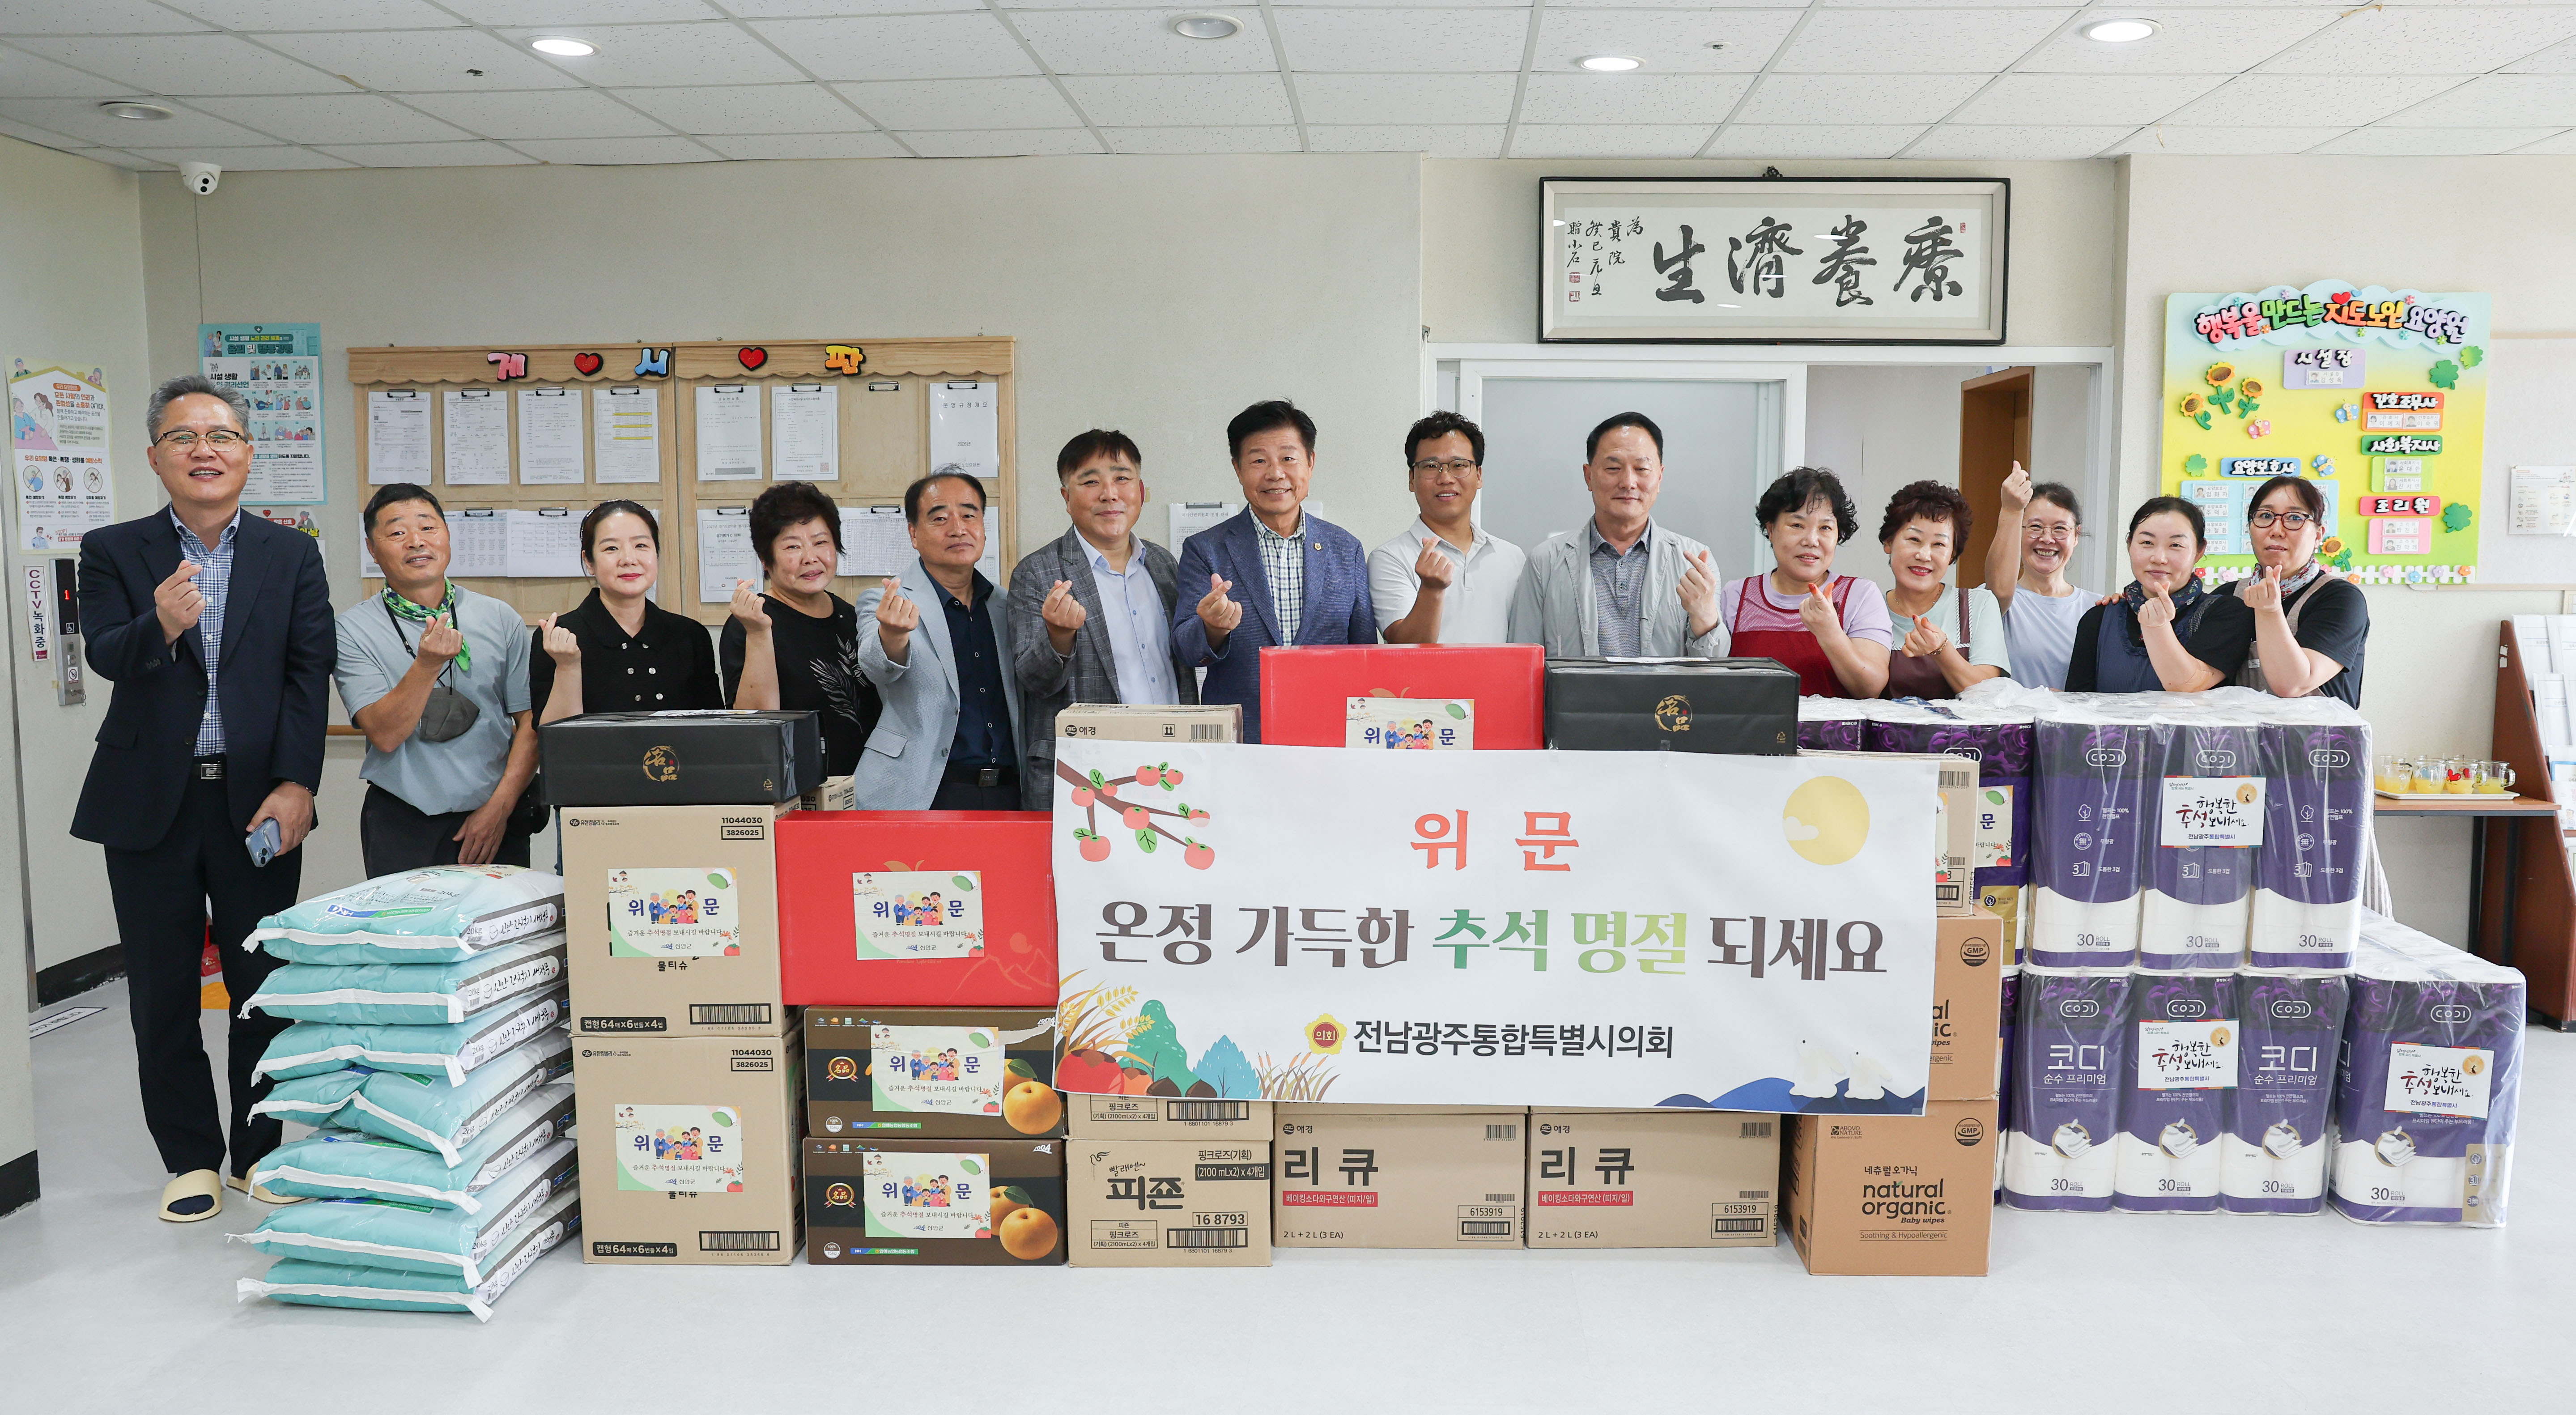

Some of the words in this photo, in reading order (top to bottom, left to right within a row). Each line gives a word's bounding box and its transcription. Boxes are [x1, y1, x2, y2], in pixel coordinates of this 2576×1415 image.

[2196, 302, 2263, 344] 행복을
[2261, 294, 2325, 330] 만드는
[2404, 306, 2469, 344] 요양원
[247, 344, 256, 353] 및
[2295, 349, 2353, 368] 시설장
[2371, 393, 2438, 410] 간호조무사
[2369, 436, 2440, 454] 사회복지사
[2230, 459, 2296, 476] 요양보호사
[2376, 497, 2430, 514] 조리원
[64, 590, 70, 600] 1
[1079, 726, 1097, 736] 애경
[1364, 727, 1380, 745] 위
[1438, 728, 1456, 746] 문
[2197, 796, 2237, 814] 행복한
[2176, 805, 2207, 829] 추석
[1411, 809, 1469, 871] 위
[1515, 811, 1579, 871] 문
[628, 900, 644, 916] 위
[703, 898, 719, 914] 문
[647, 928, 672, 936] 추석명절
[673, 928, 697, 936] 보내시길
[1094, 900, 1214, 966] 온정
[1236, 905, 1415, 969] 가득한
[1432, 909, 1550, 972] 추석
[1570, 910, 1687, 974] 명절
[1706, 916, 1887, 981] 되세요
[2077, 934, 2094, 946] 30
[658, 961, 687, 971] 물티슈
[584, 1020, 599, 1028] 캡형
[1315, 1030, 1335, 1041] 의회
[1353, 1019, 1673, 1059] 전남광주통합특별시의회
[2048, 1045, 2104, 1070] 코디
[834, 1065, 850, 1073] 名品
[2422, 1064, 2462, 1084] 행복한
[2043, 1074, 2063, 1084] 순수
[2066, 1074, 2106, 1084] 프리미엄
[2401, 1071, 2432, 1096] 추석
[2410, 1100, 2457, 1109] 전남광주통합특별시
[1297, 1125, 1313, 1134] 애경
[1199, 1150, 1252, 1161] 핑크로즈(기획)
[1246, 1166, 1265, 1178] 4개입
[1865, 1166, 1891, 1176] 네츄럴
[1892, 1166, 1917, 1176] 오가닉
[1106, 1176, 1184, 1210] 피죤
[1863, 1178, 1943, 1198] natural
[1286, 1194, 1346, 1203] 베이킹소다와구연산
[1348, 1194, 1374, 1204] (띠지/일)
[1862, 1201, 1946, 1219] organic
[1196, 1214, 1210, 1224] 16
[1214, 1214, 1245, 1224] 8793
[1860, 1232, 1890, 1240] Soothing
[1899, 1232, 1947, 1240] Hypoallergenic
